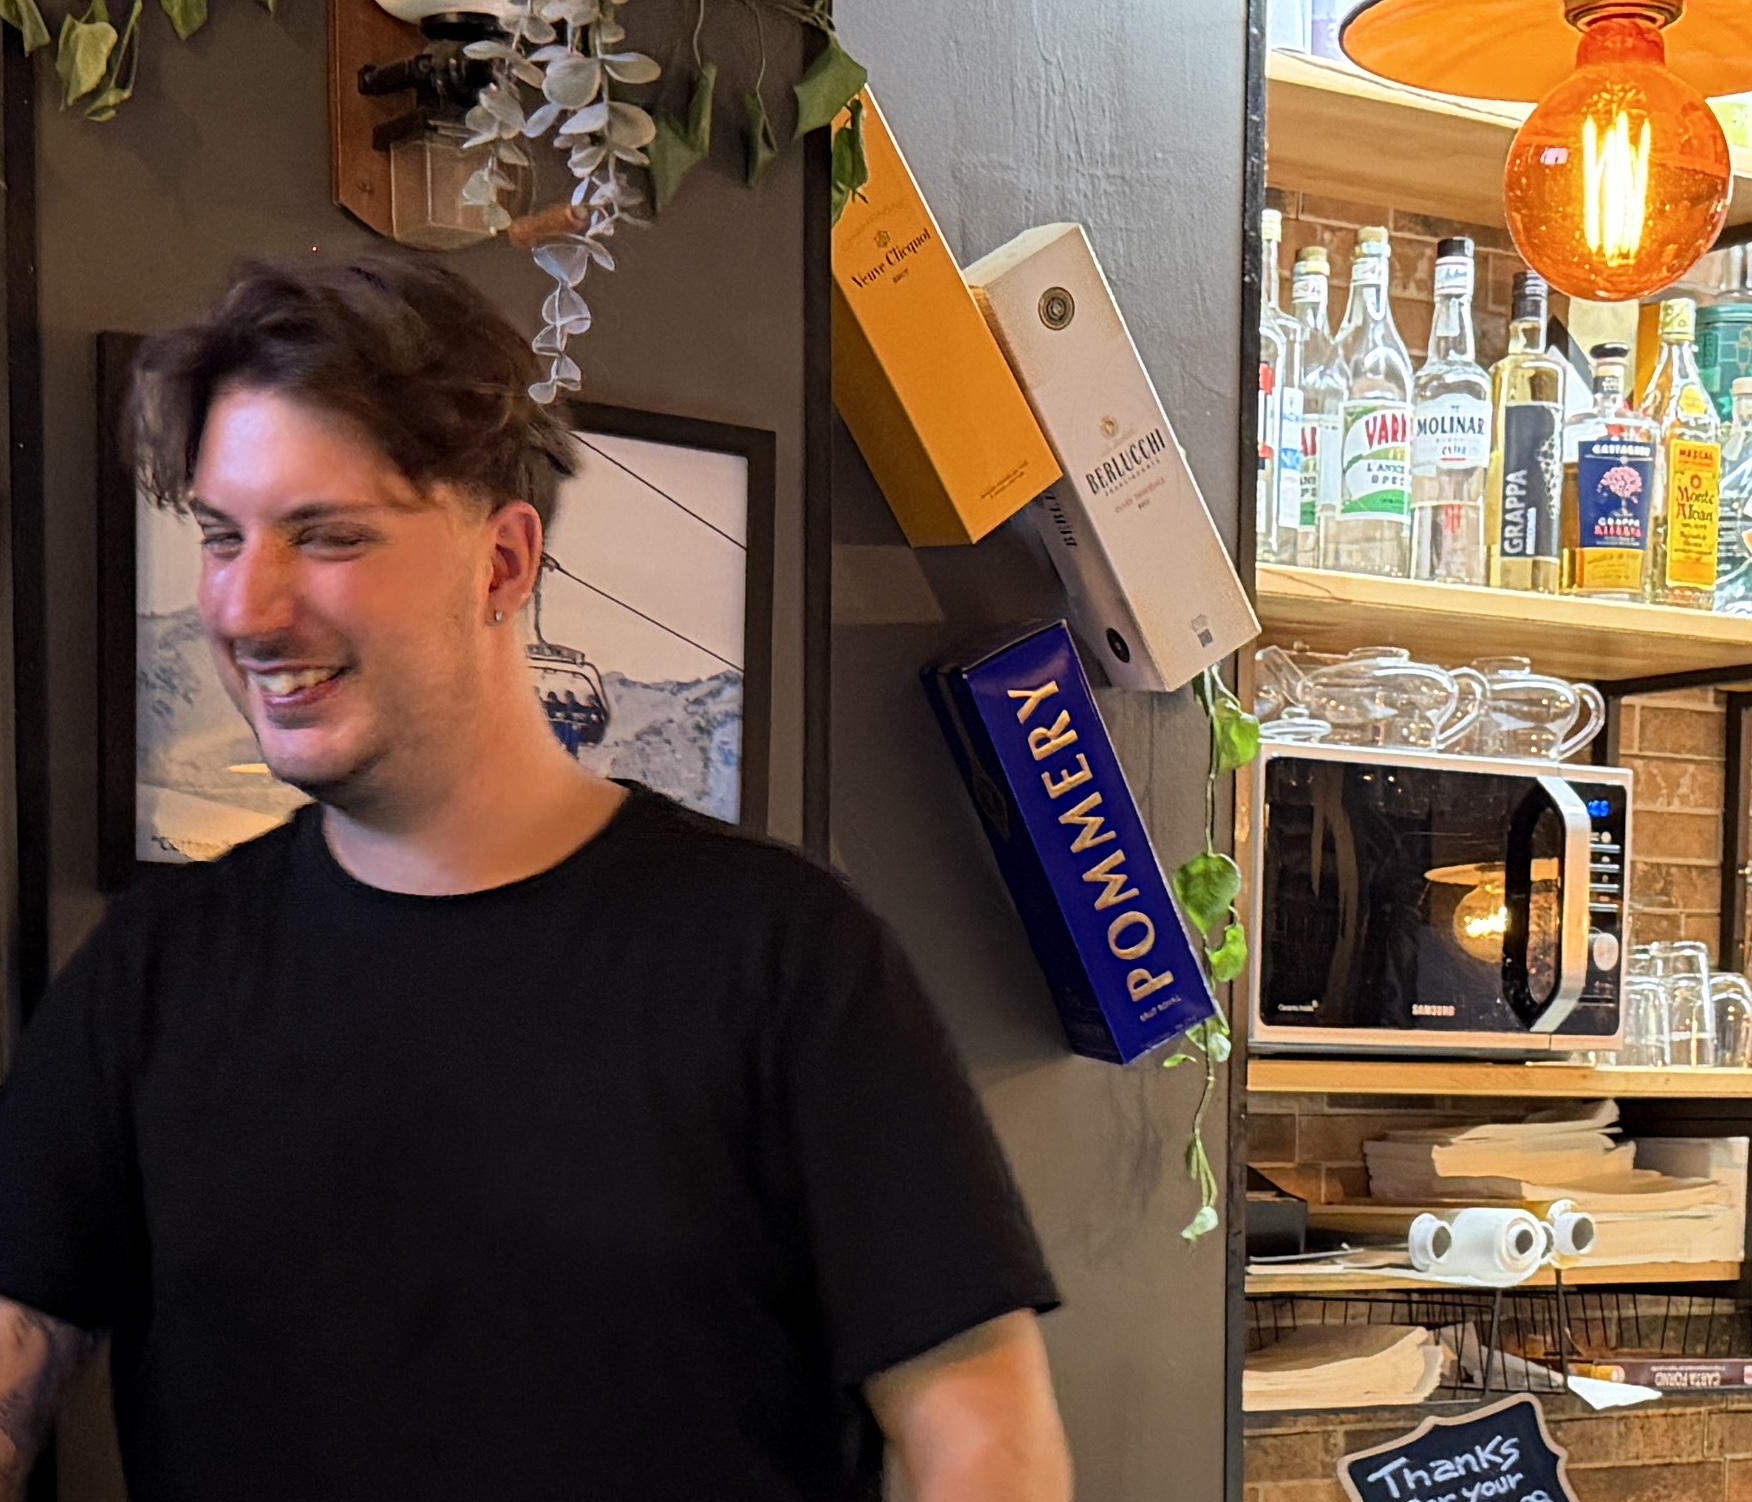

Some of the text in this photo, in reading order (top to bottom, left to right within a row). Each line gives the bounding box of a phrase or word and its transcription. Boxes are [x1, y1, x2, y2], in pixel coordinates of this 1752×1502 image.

[851, 227, 931, 288] Veuve Clicquot
[1085, 428, 1166, 495] BERLUCCHI
[1503, 469, 1528, 555] GRAPPA
[1006, 679, 1175, 1003] POMMERY
